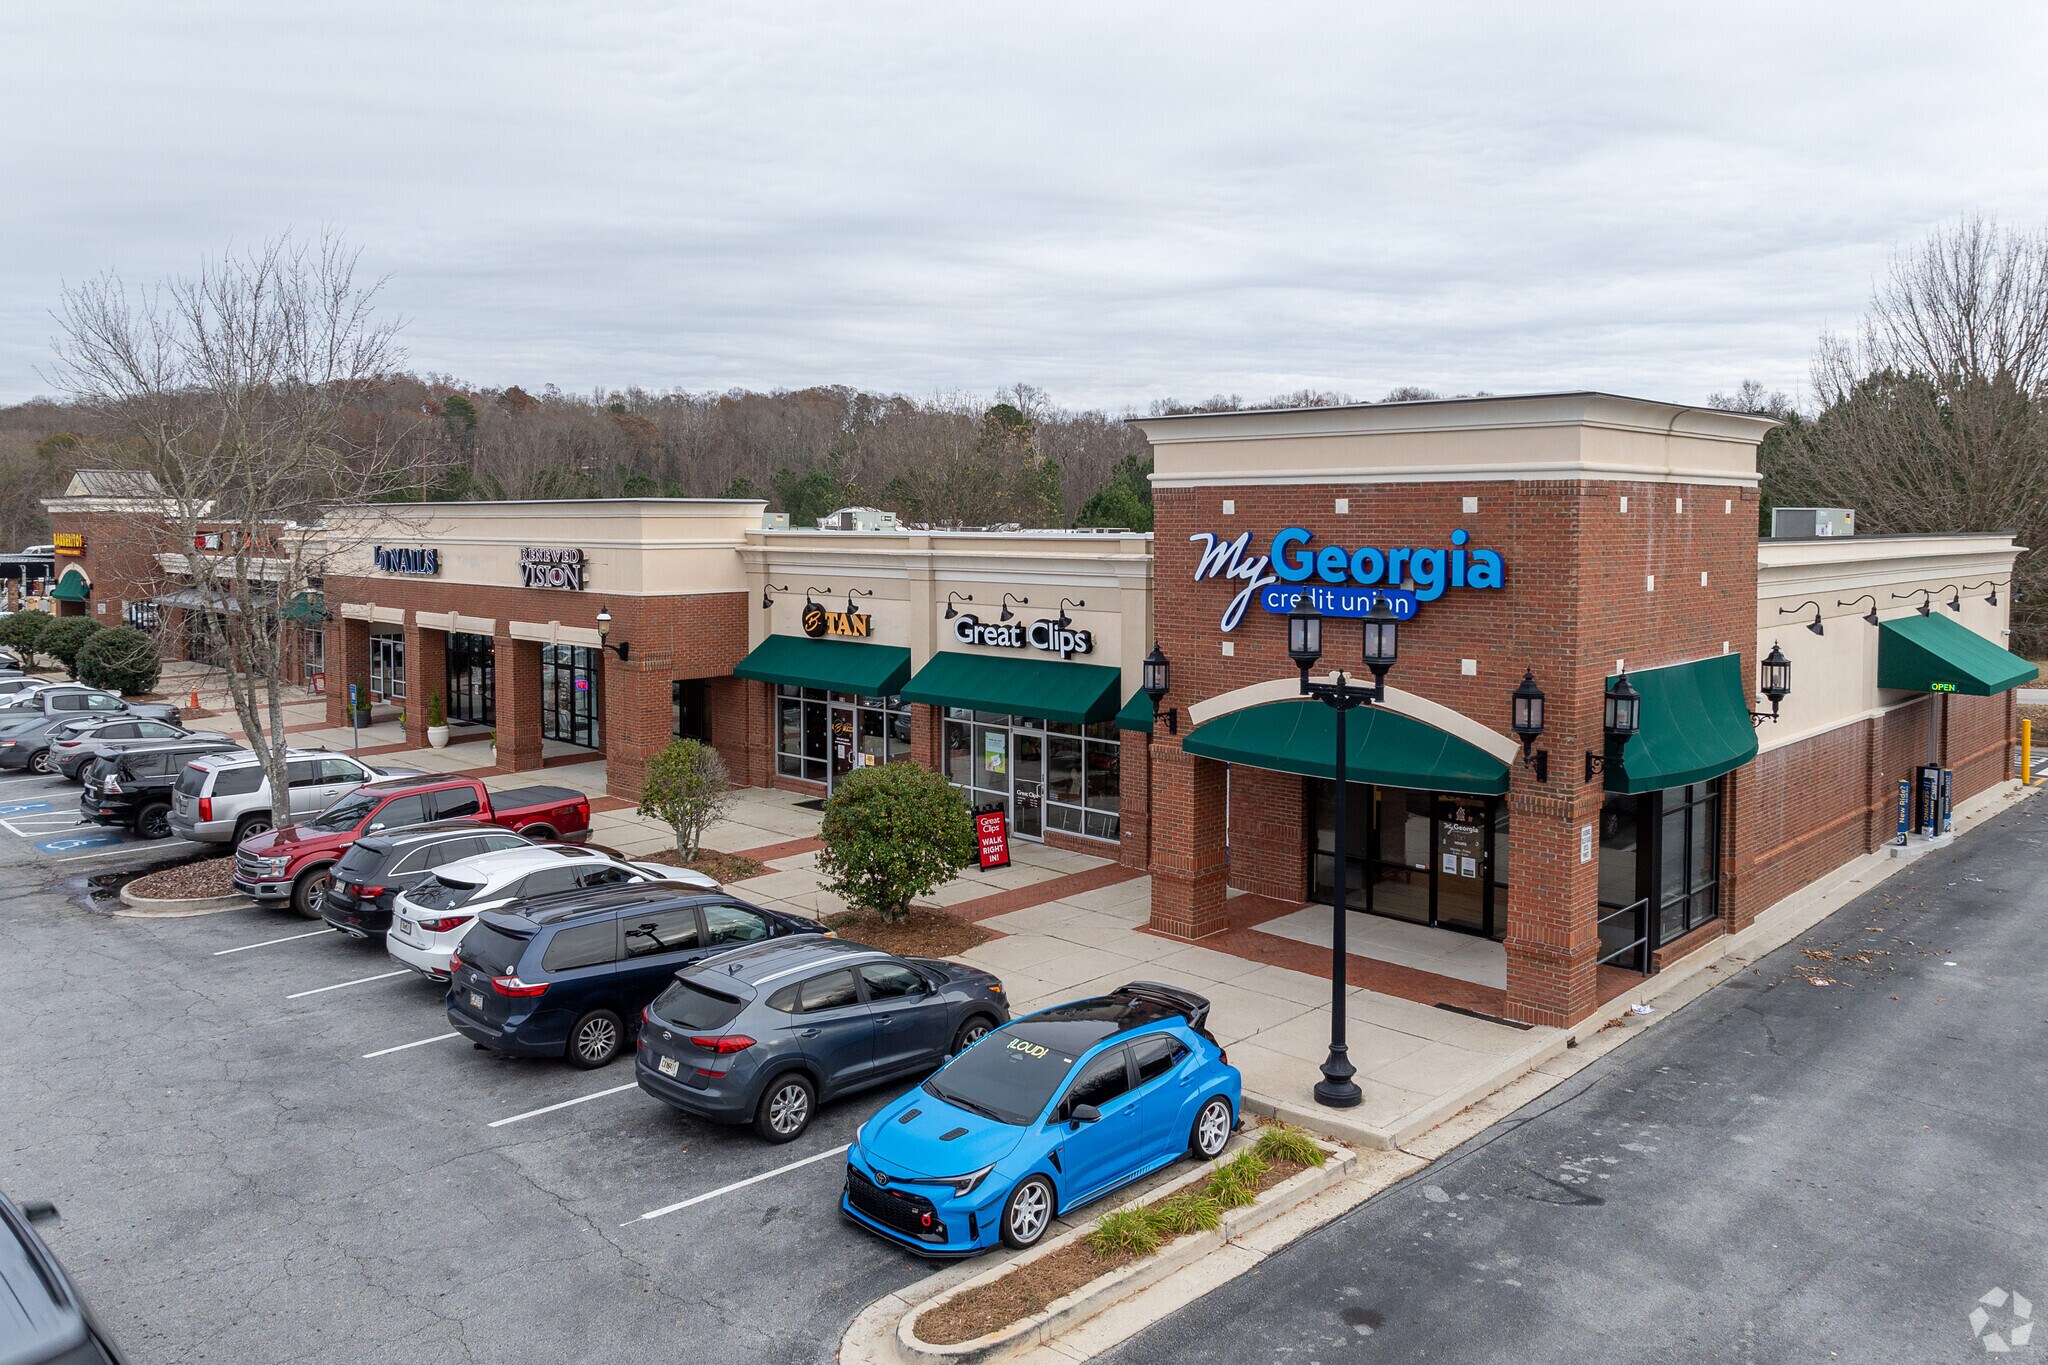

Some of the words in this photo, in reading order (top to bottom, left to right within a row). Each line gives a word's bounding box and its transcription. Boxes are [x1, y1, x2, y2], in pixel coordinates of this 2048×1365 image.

[519, 547, 580, 564] RENEWED
[389, 548, 435, 575] NAILS
[518, 562, 581, 591] VISION
[1189, 531, 1280, 632] My
[1270, 527, 1505, 602] Georgia
[824, 611, 868, 637] TAN
[954, 614, 1021, 647] Great
[1028, 619, 1088, 659] Clips
[1931, 682, 1956, 692] OPEN
[980, 817, 1001, 826] Great
[982, 824, 1000, 834] Clips
[1453, 823, 1479, 834] Georgia
[982, 836, 1003, 846] WALK
[982, 844, 1004, 855] RIGHT
[989, 854, 1000, 863] IN!
